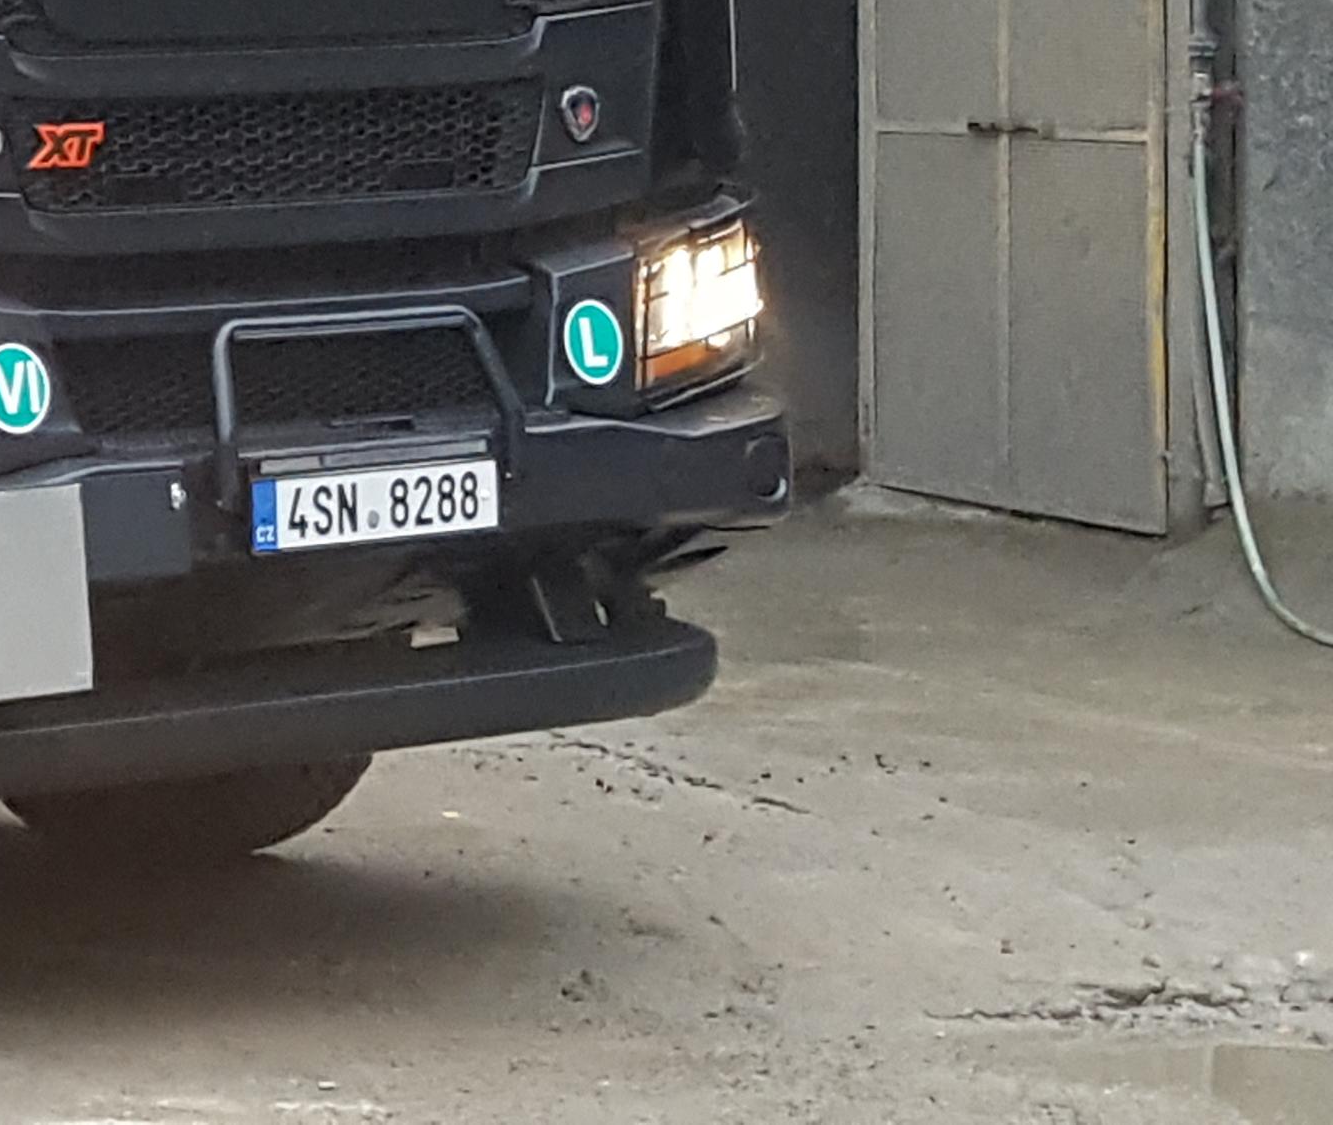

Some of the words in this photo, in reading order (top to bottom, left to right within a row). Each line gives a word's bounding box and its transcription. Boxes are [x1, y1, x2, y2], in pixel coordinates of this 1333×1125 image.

[27, 121, 105, 169] XT
[578, 316, 609, 369] L
[287, 481, 359, 539] 4SN
[389, 471, 480, 528] 8288
[255, 524, 276, 544] CZ
